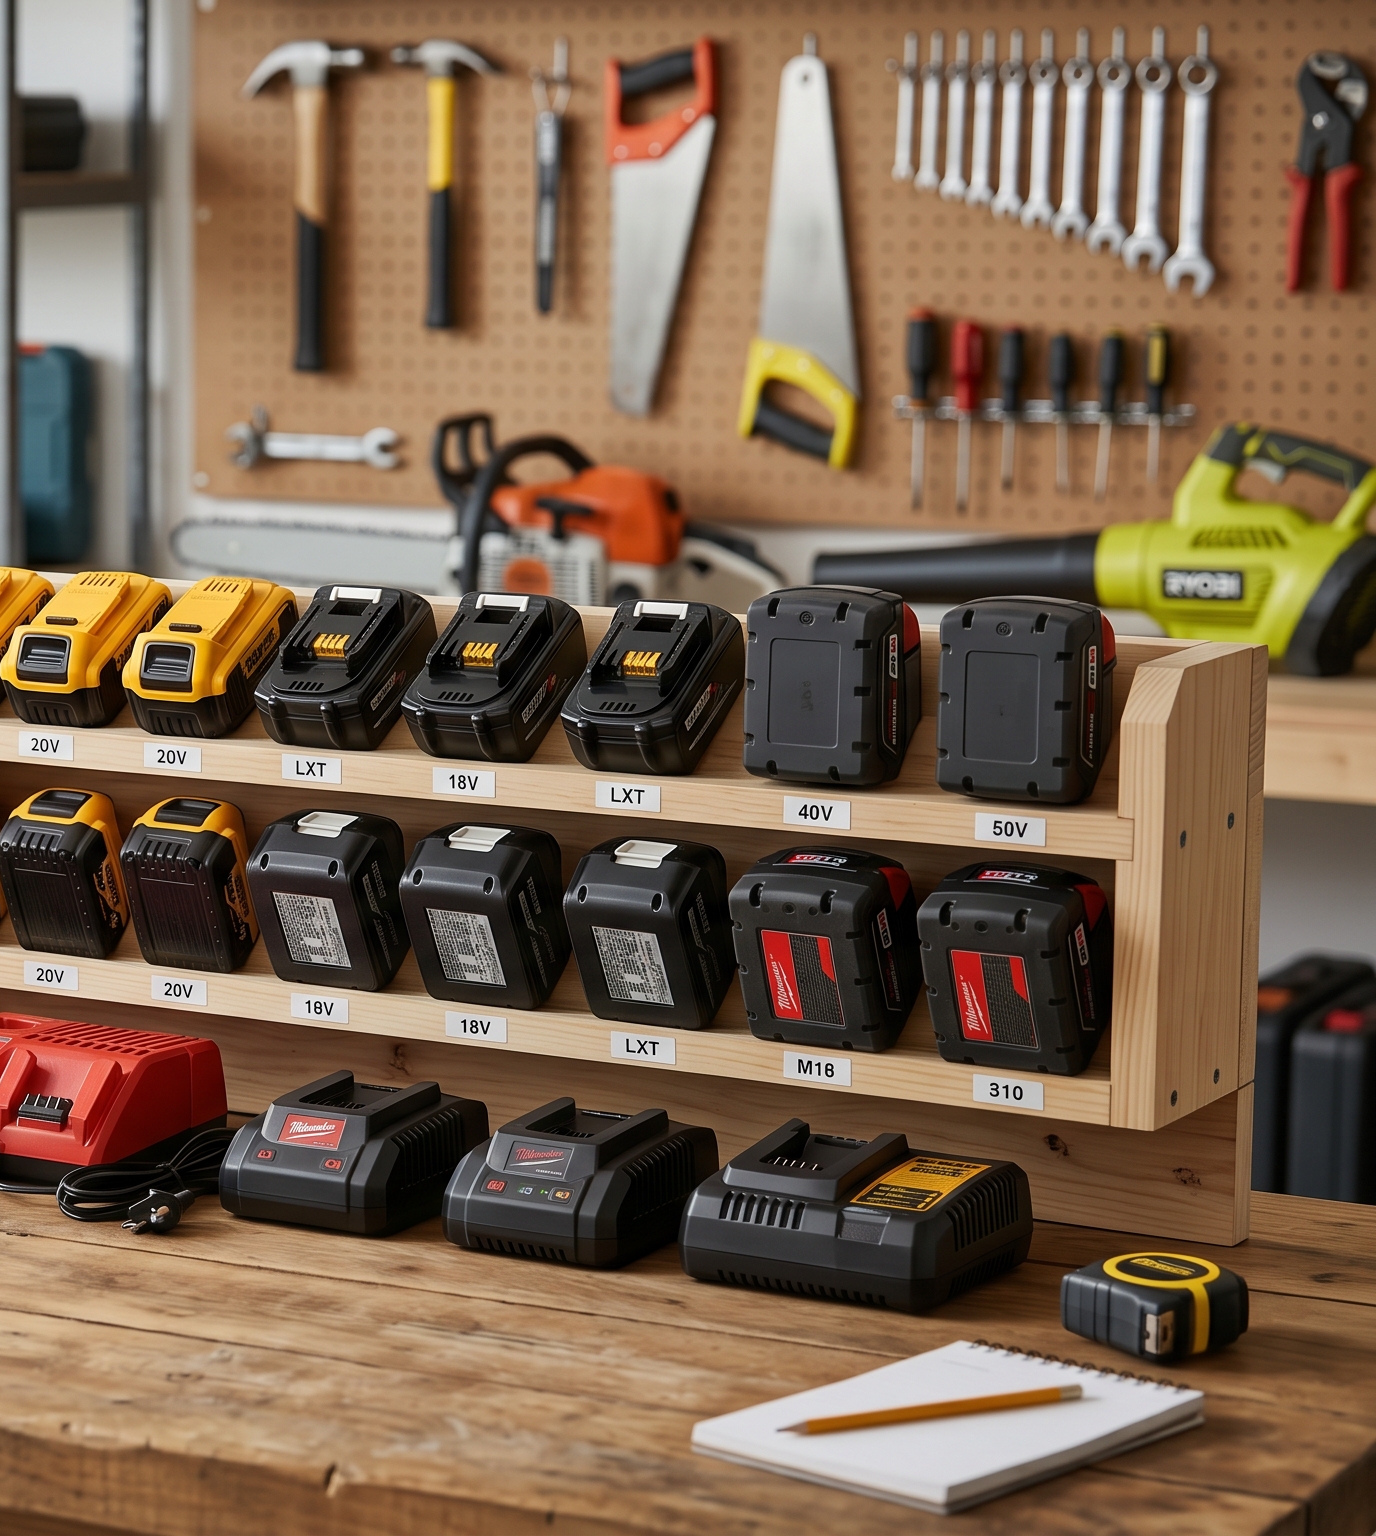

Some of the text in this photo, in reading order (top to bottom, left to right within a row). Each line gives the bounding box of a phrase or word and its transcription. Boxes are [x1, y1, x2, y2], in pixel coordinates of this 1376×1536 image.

[31, 737, 60, 753] 20V
[157, 749, 187, 765] 20V
[296, 760, 327, 777] LXT
[449, 774, 479, 791] 18V
[611, 786, 646, 805] LXT
[798, 804, 834, 822] 40V
[992, 820, 1028, 838] 50V
[36, 967, 65, 984] 20V
[164, 982, 193, 999] 20V
[305, 999, 334, 1016] 18V
[460, 1018, 491, 1035] 18V
[625, 1038, 660, 1056] LXT
[989, 1082, 1024, 1101] 310
